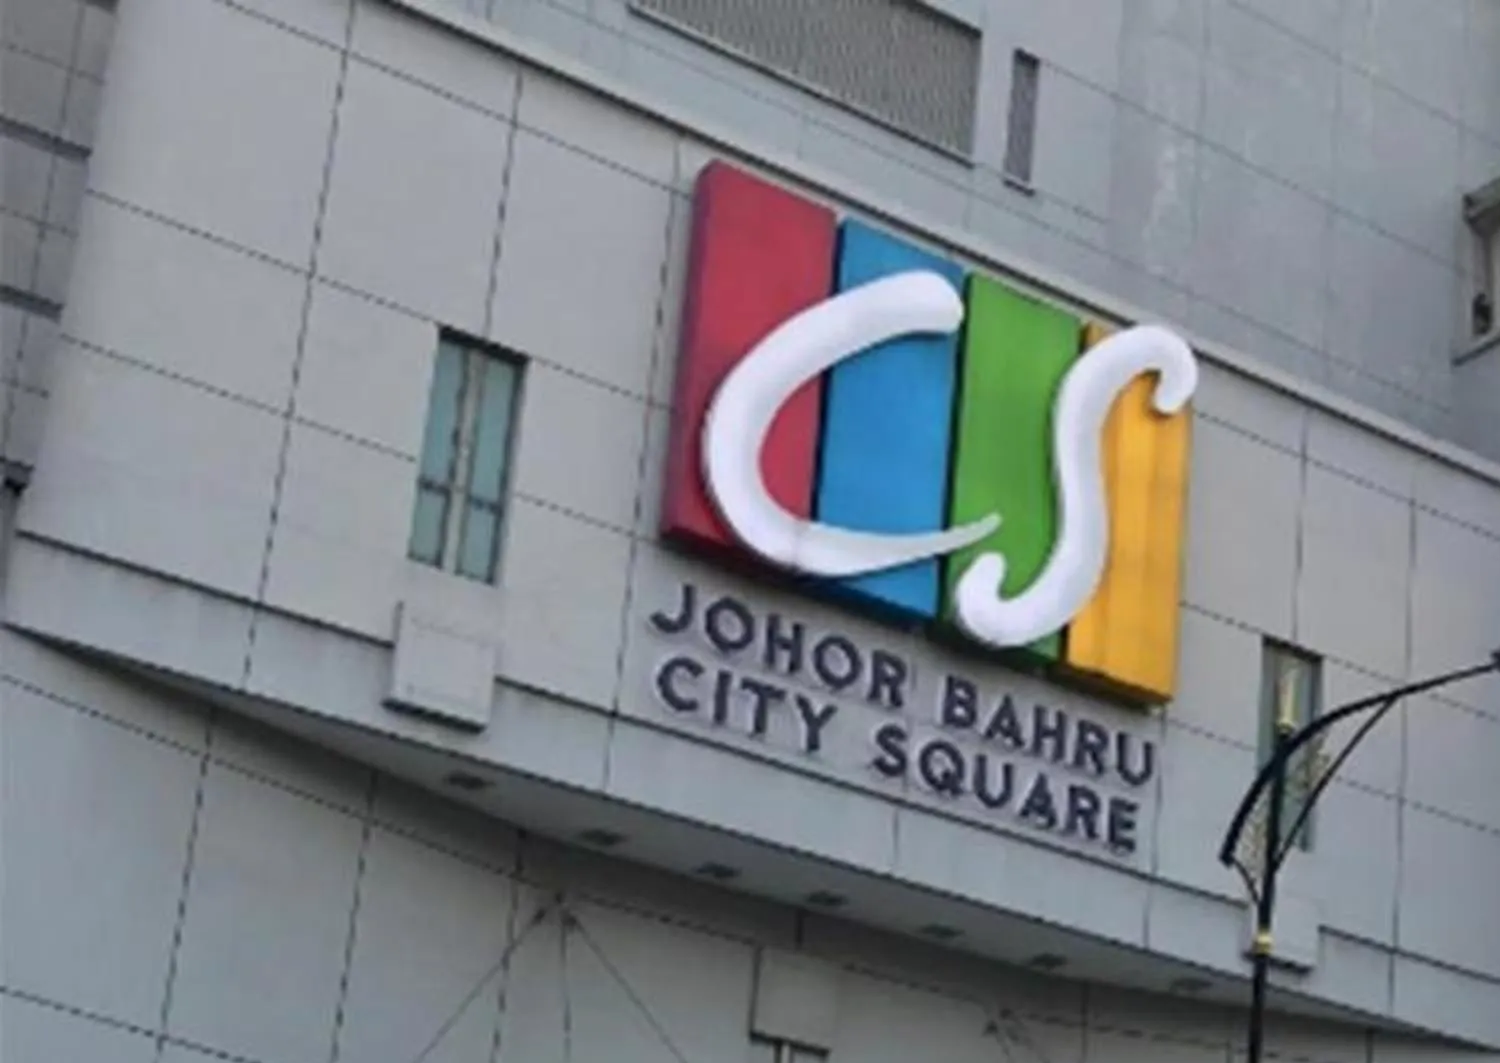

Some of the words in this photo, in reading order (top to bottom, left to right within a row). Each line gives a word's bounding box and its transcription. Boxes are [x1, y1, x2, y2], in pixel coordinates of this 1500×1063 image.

[703, 268, 1198, 648] CS
[650, 584, 908, 708] JOHOR
[941, 674, 1155, 786] BAHRU
[656, 656, 838, 753] CITY
[872, 723, 1139, 853] SQUARE
